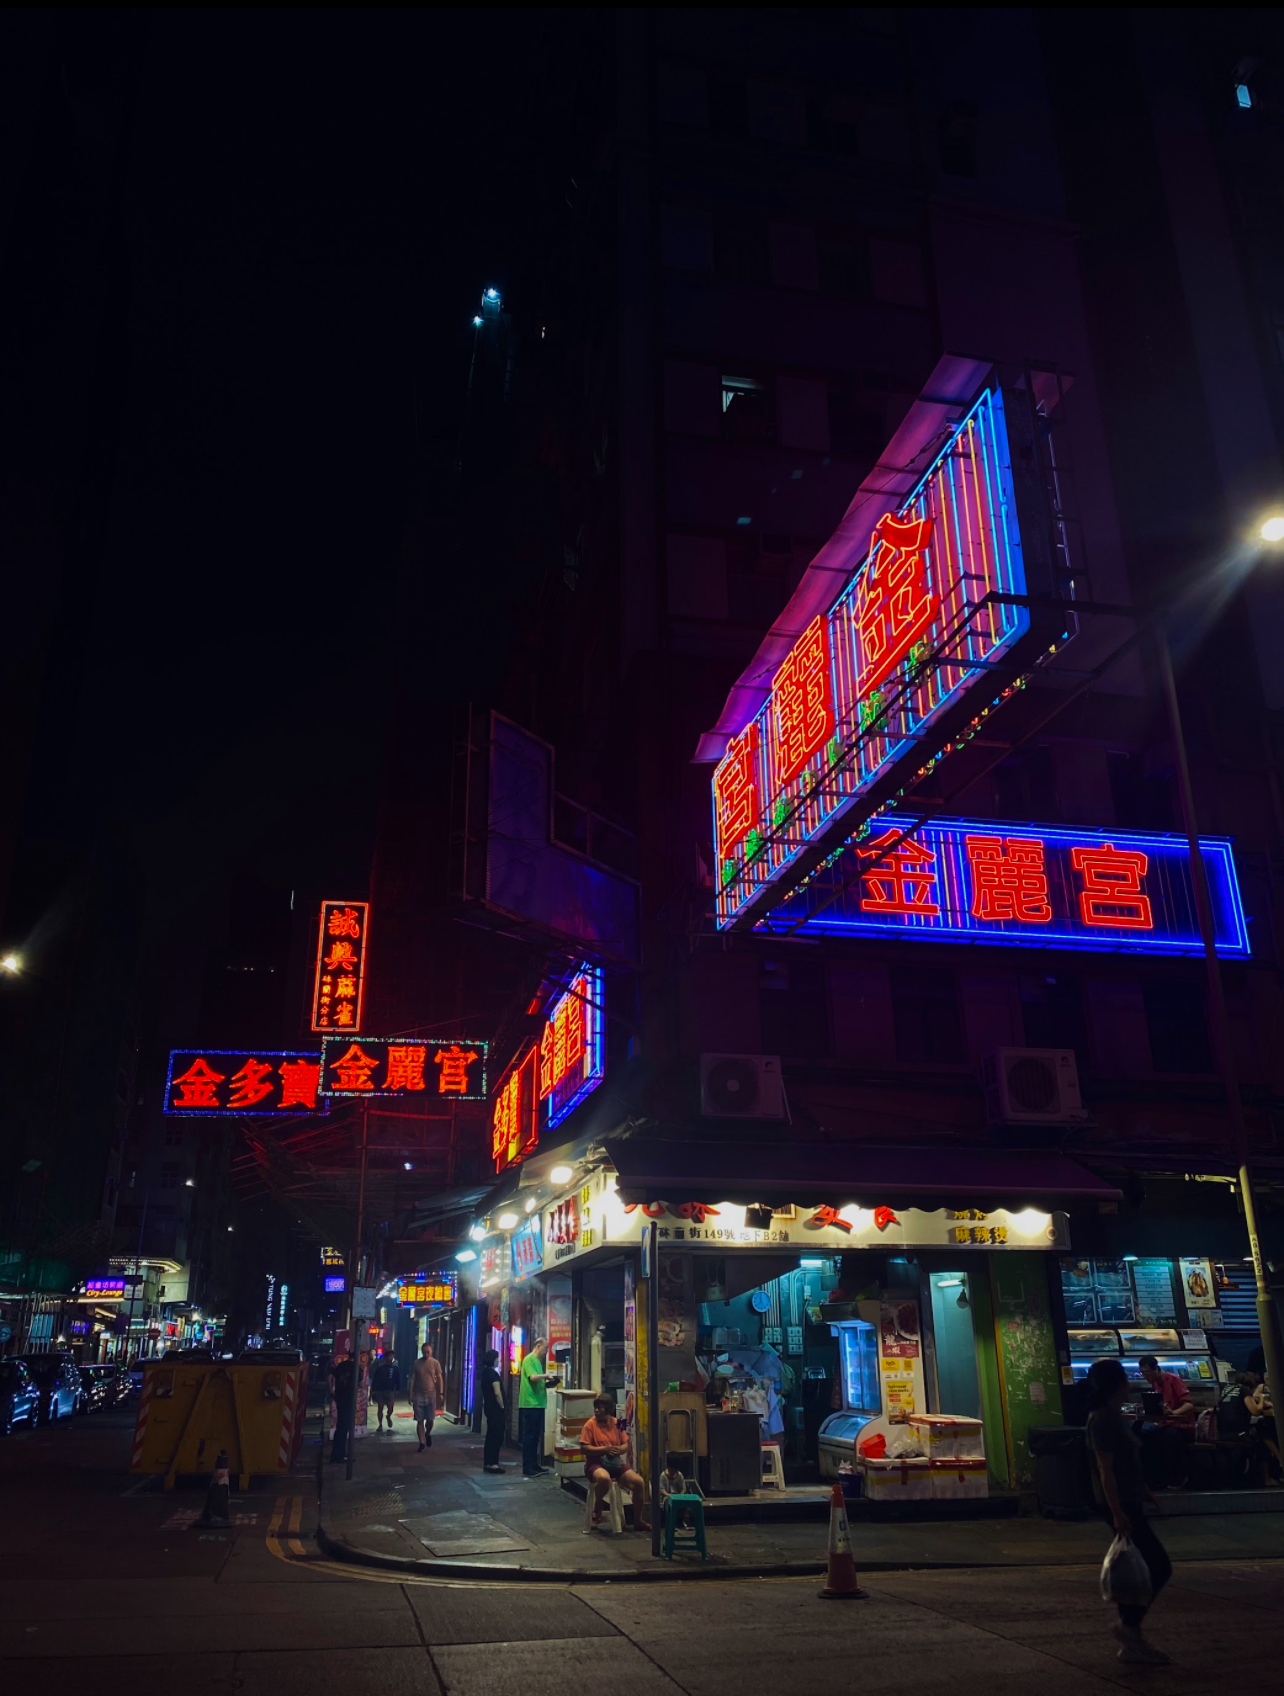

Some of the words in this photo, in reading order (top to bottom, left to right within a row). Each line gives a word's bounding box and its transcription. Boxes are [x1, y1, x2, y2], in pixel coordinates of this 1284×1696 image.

[855, 827, 1154, 931] 金麗宮
[172, 1057, 320, 1108] 金多寶
[329, 1043, 478, 1095] 金麗宮
